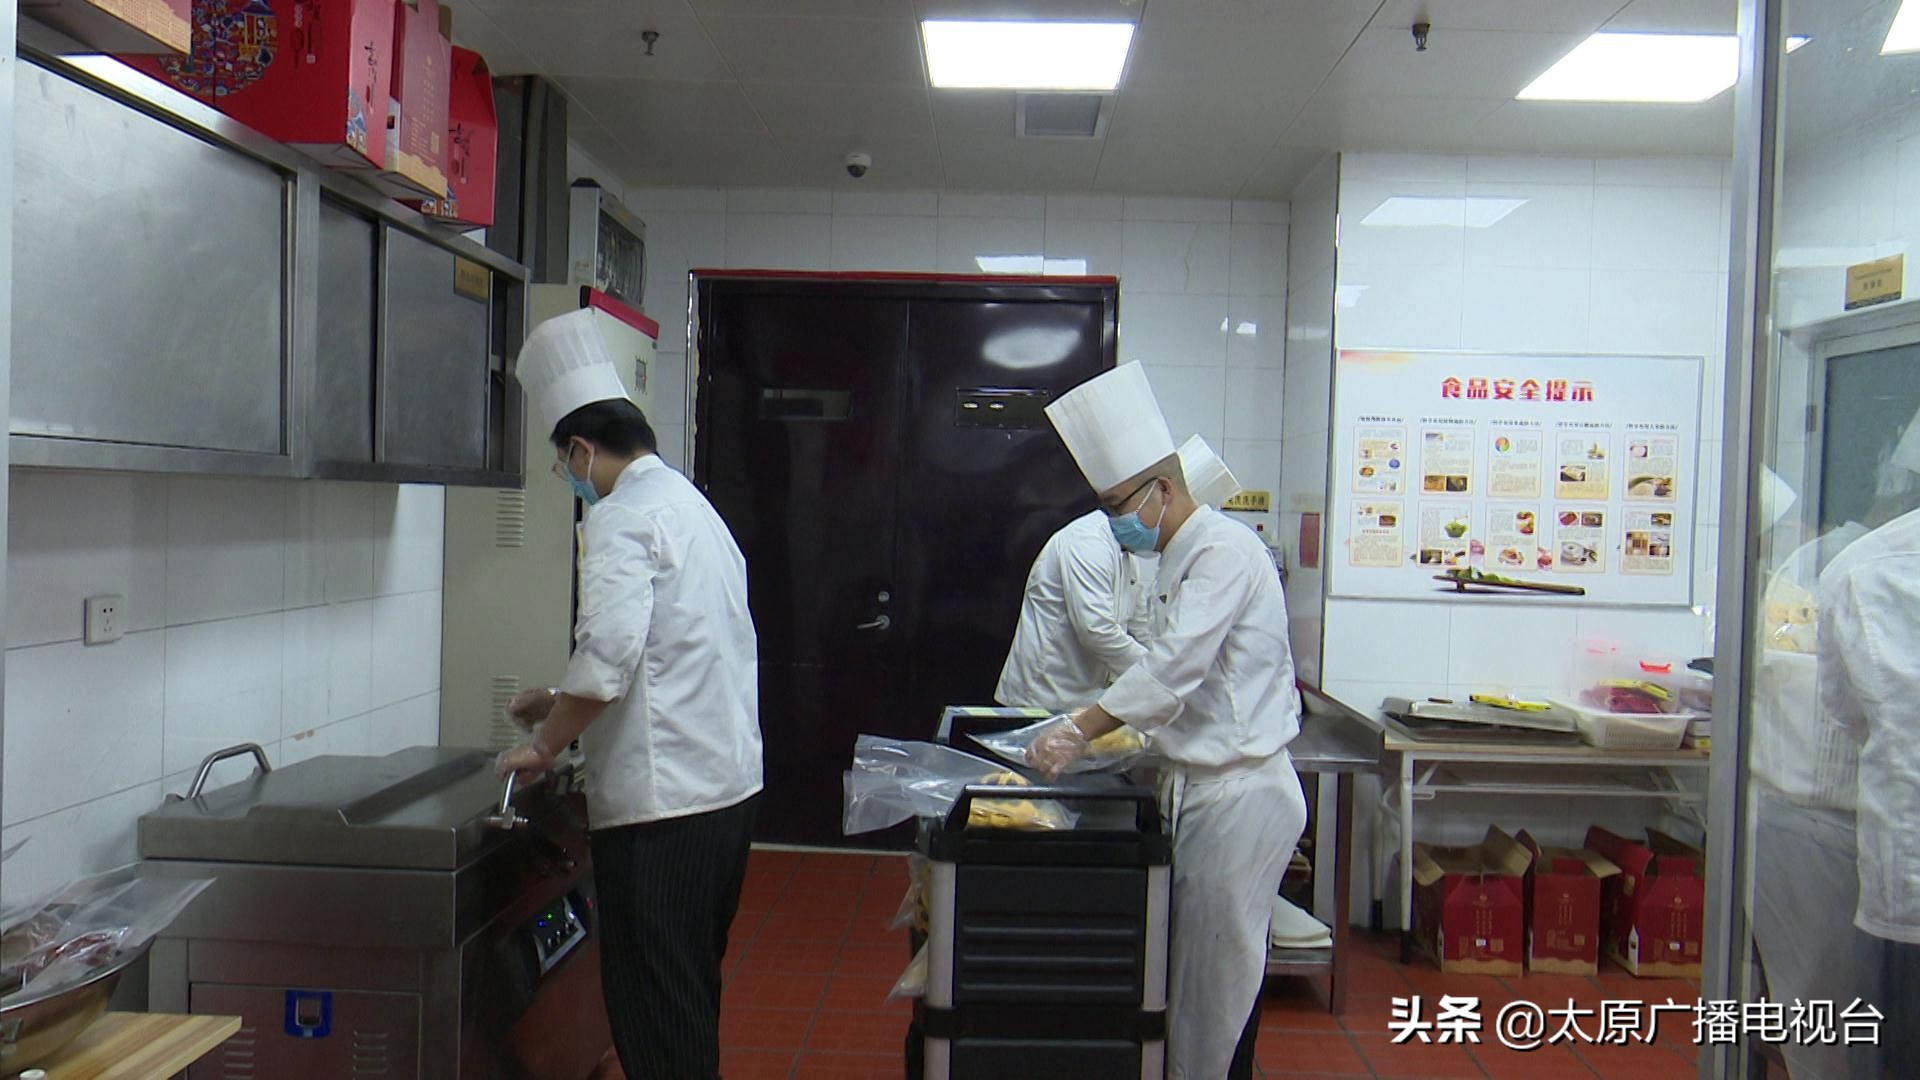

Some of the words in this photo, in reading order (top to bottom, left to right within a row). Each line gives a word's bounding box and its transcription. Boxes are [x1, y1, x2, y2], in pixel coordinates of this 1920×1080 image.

[1441, 376, 1594, 402] 食品安全提示
